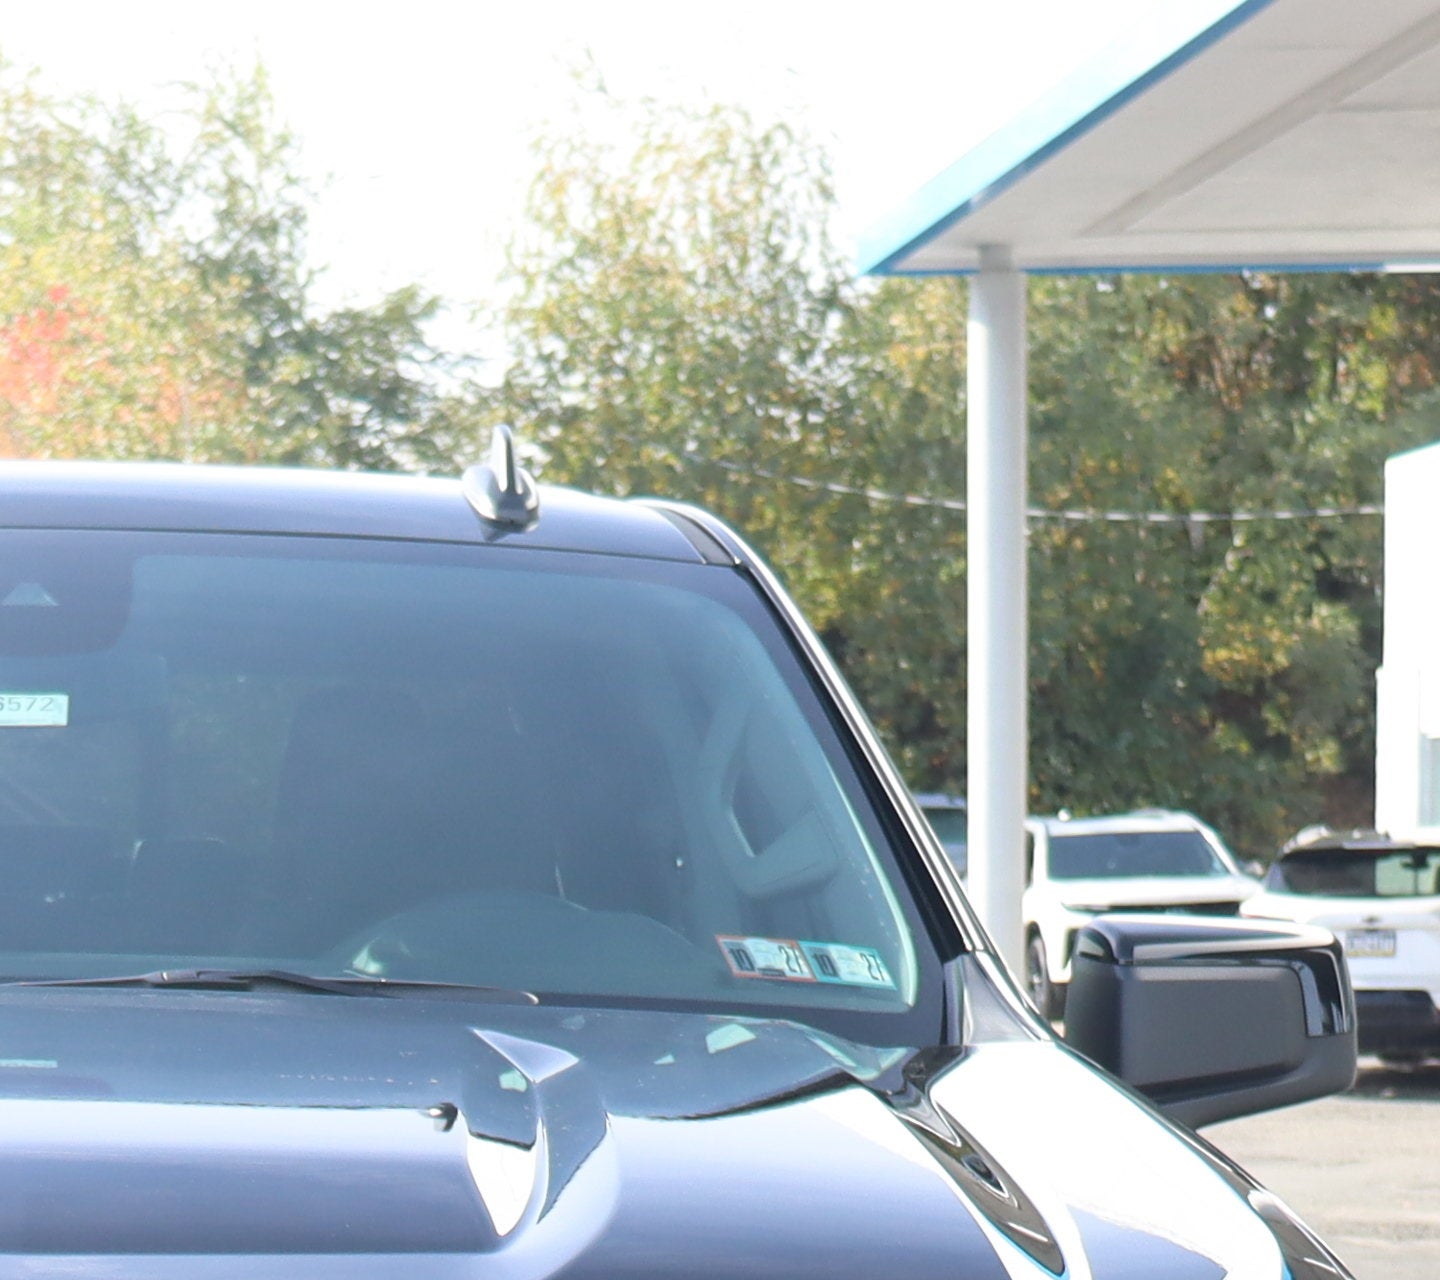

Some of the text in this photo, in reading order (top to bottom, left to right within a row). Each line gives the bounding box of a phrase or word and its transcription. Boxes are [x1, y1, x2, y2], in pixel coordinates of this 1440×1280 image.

[727, 945, 804, 975] 10 27
[857, 952, 885, 982] 27
